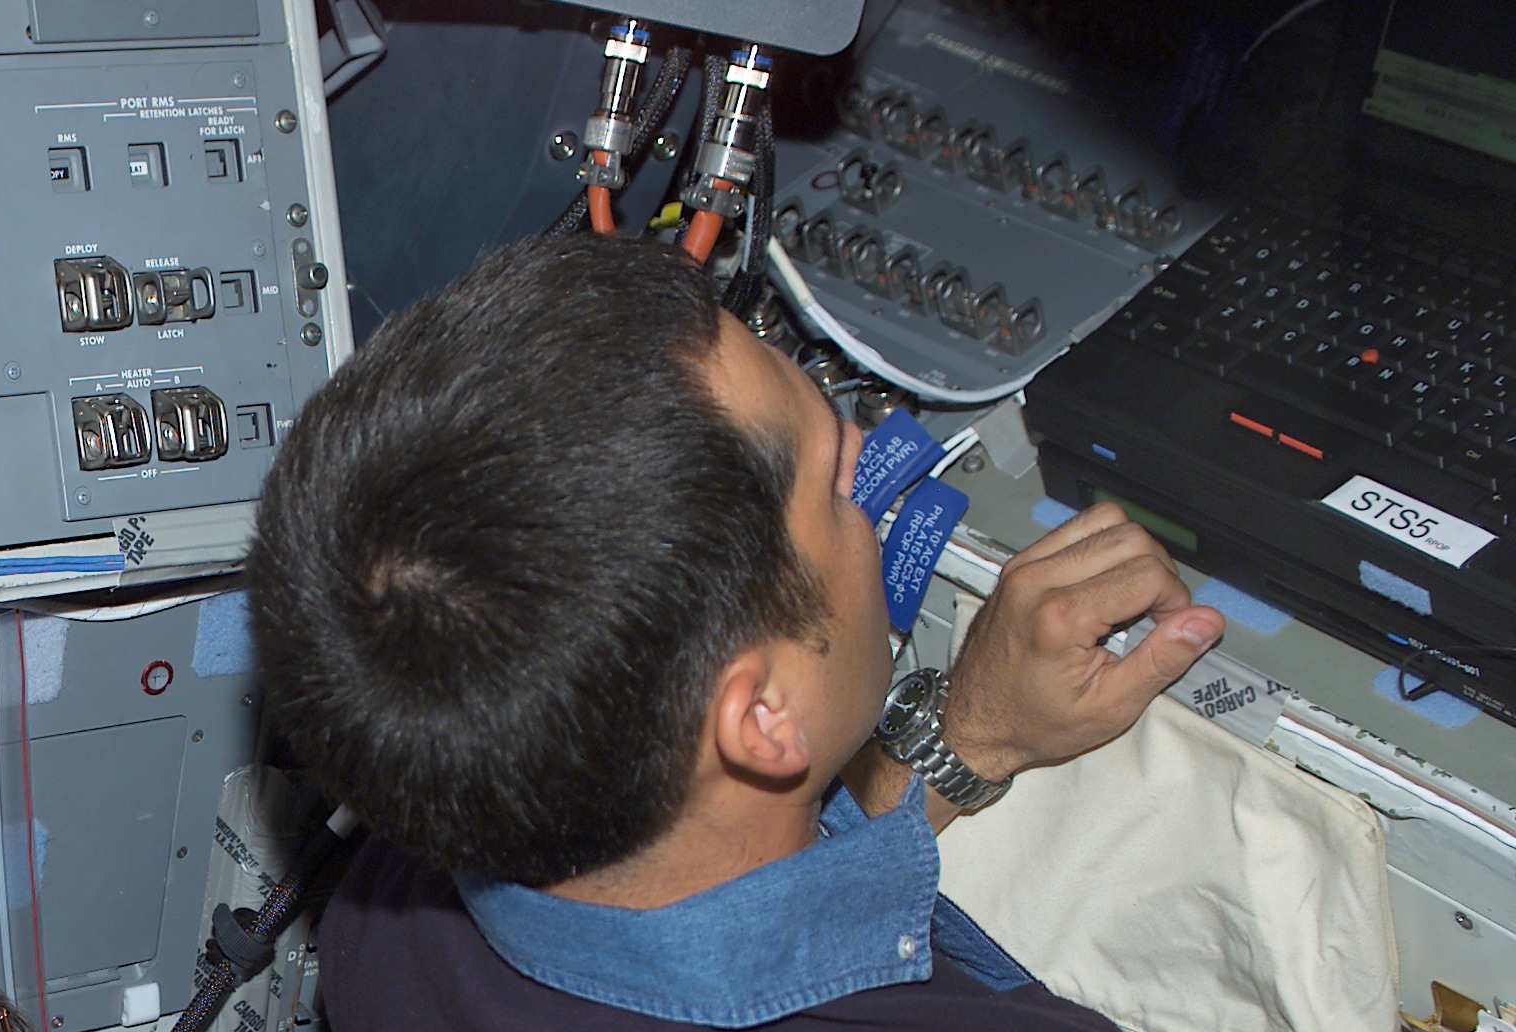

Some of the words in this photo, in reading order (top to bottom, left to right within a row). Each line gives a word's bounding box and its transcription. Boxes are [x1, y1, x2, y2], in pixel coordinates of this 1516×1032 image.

[120, 97, 148, 109] PORT
[151, 96, 175, 108] RMS
[140, 108, 186, 119] RETENTION
[188, 106, 224, 116] LATCHES
[207, 115, 235, 126] READY
[199, 126, 217, 136] FOR
[218, 125, 245, 135] LATCH
[57, 133, 78, 143] RMS
[65, 244, 98, 255] DEPLOY
[145, 257, 180, 268] RELEASE
[262, 286, 279, 295] MID
[157, 329, 185, 339] LATCH
[79, 336, 105, 346] STOW
[121, 368, 153, 379] HEATER
[1459, 361, 1476, 374] K
[1379, 369, 1395, 380] N
[1495, 375, 1506, 386] L
[95, 383, 102, 392] A
[126, 378, 151, 388] AUTO
[174, 376, 181, 385] B
[1412, 382, 1429, 393] M
[859, 440, 880, 466] EXT
[888, 440, 918, 472] PWR)
[140, 468, 158, 478] OFF
[926, 505, 944, 529] PNL
[1351, 491, 1438, 538] STS5
[902, 510, 925, 559] (RPOP
[912, 529, 928, 554] A15
[126, 531, 155, 566] TAPE
[886, 552, 909, 587] PWR)
[911, 566, 926, 594] EXT
[1192, 677, 1231, 704] TAPE
[1204, 685, 1256, 718] CARGO
[233, 1000, 265, 1032] CARGO
